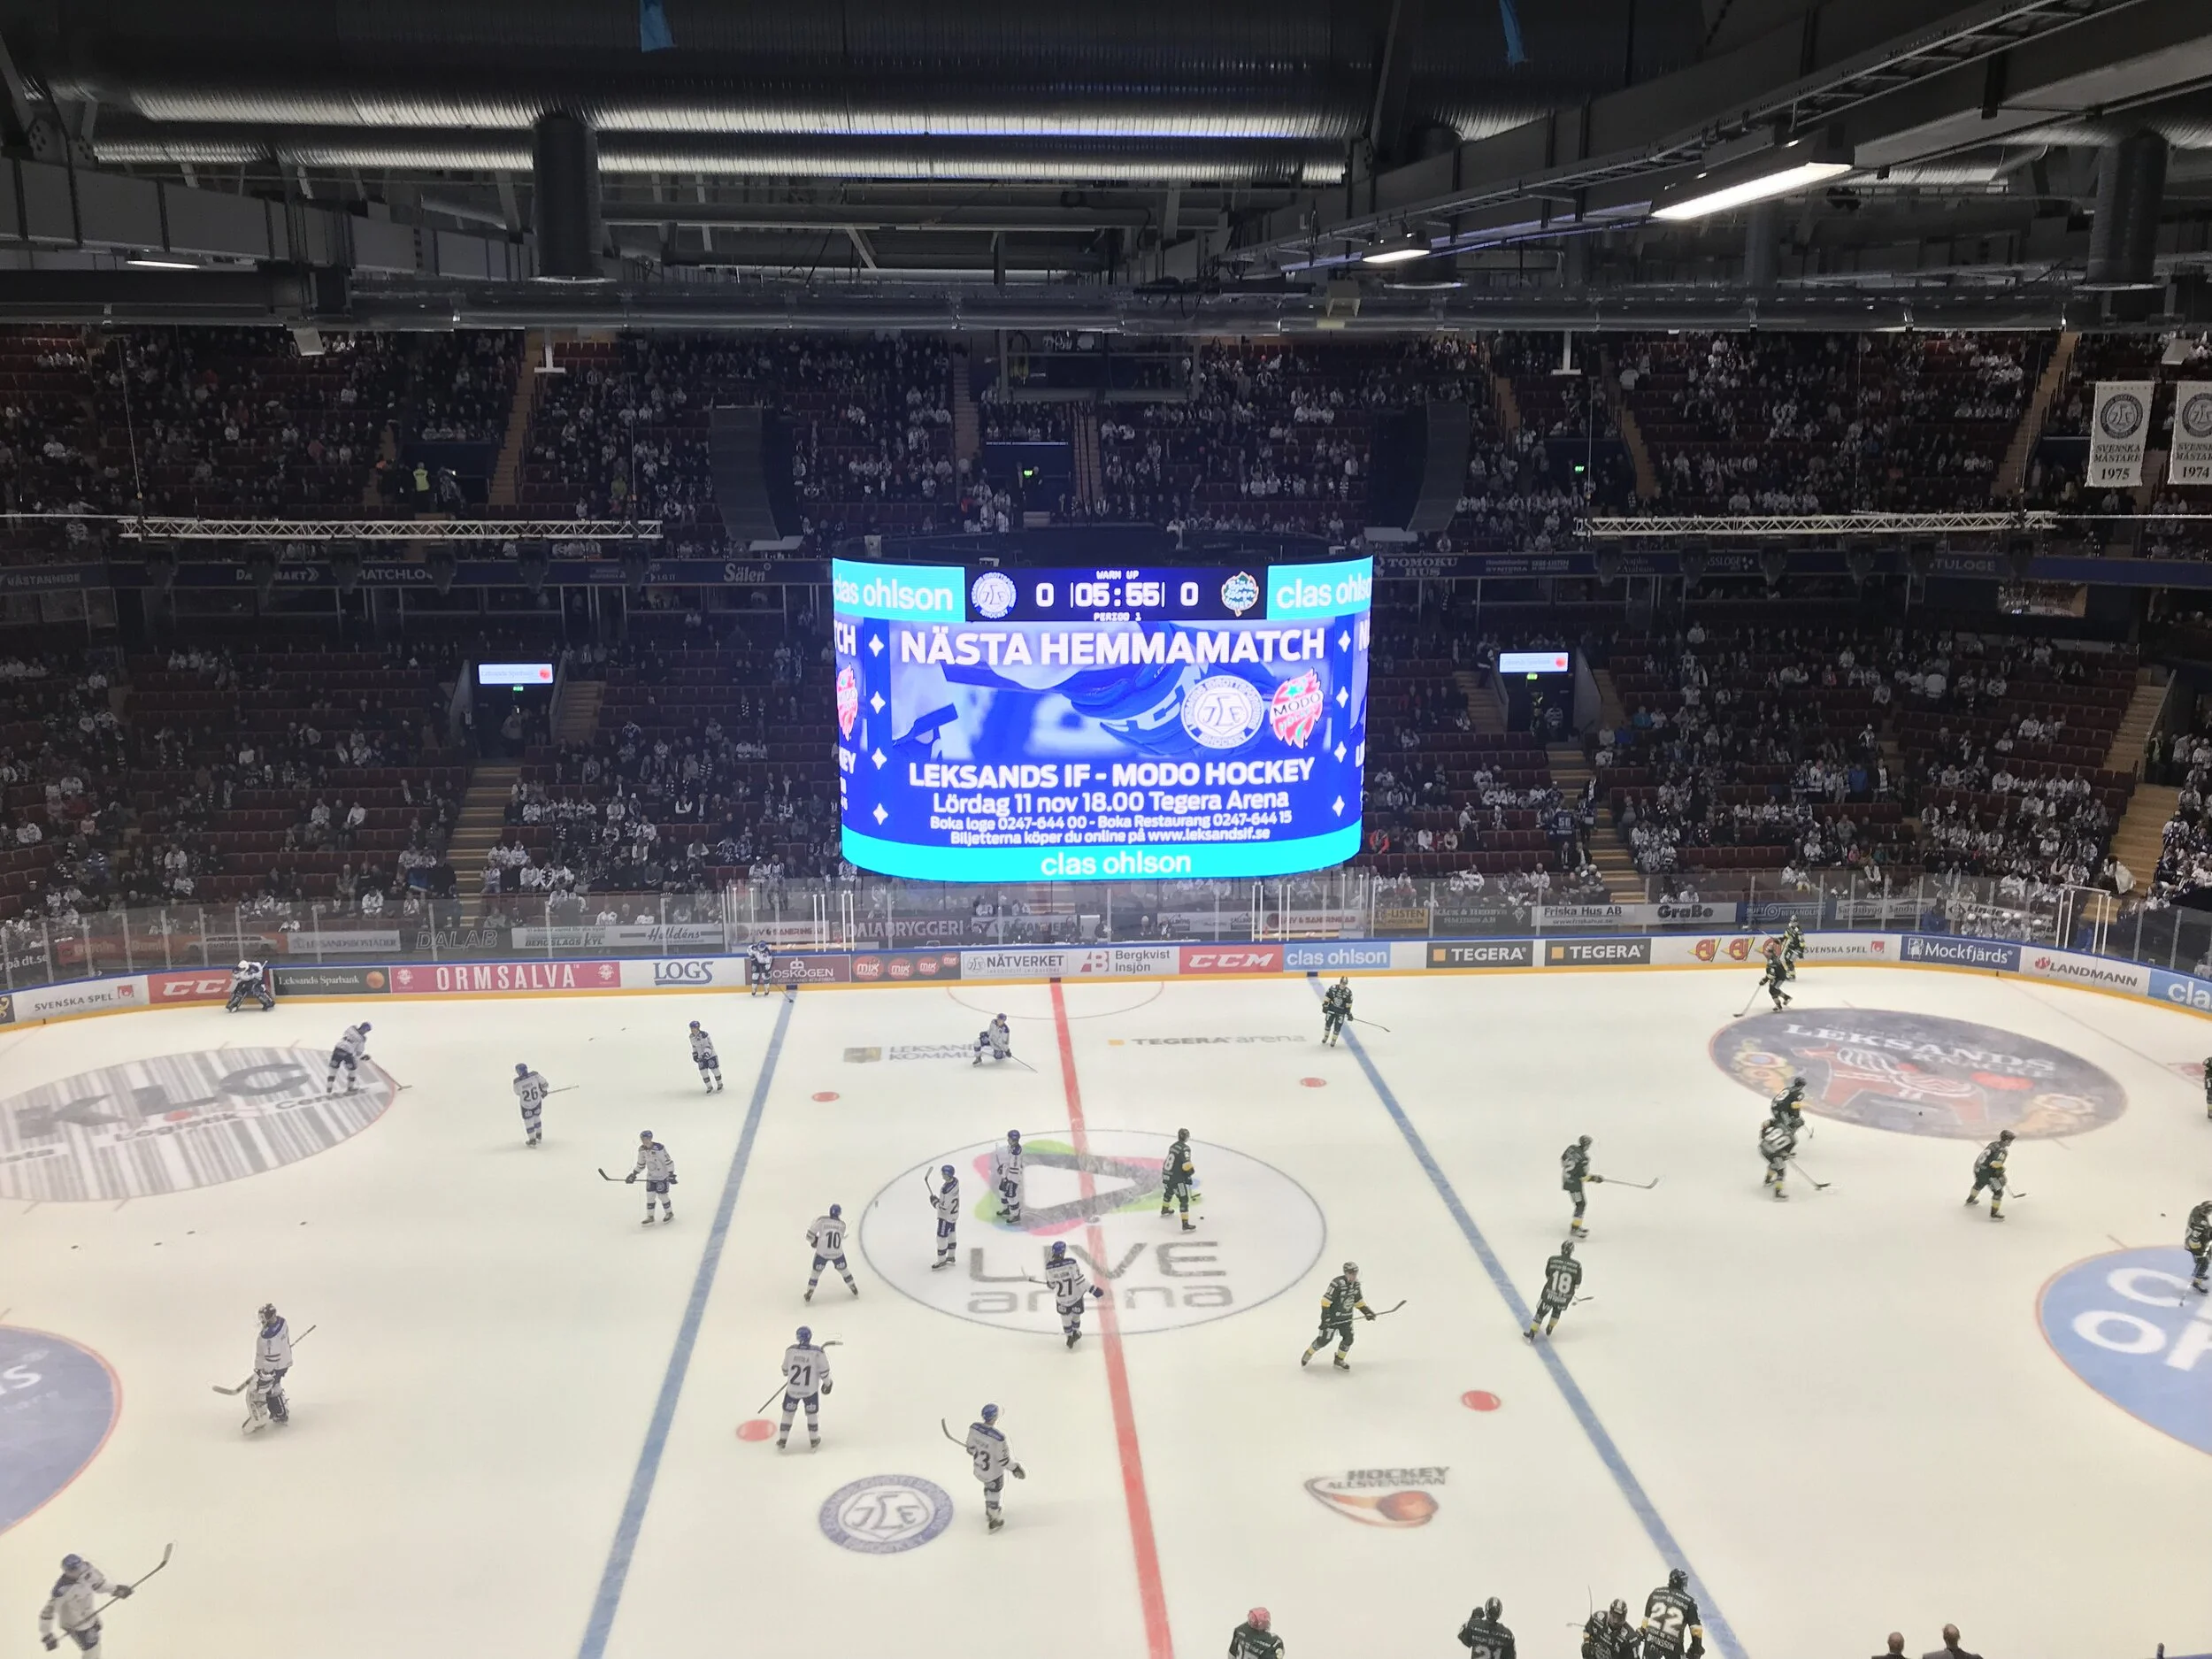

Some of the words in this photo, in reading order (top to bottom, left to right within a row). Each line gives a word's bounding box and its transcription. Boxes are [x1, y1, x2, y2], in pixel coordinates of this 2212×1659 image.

[2101, 468, 2131, 480] 1975
[2183, 466, 2210, 479] 1974
[1096, 571, 1122, 580] WARM
[1125, 571, 1140, 580] UP
[863, 577, 954, 611] ohlson
[1035, 582, 1055, 607] 0
[1179, 581, 1199, 607] 0
[1276, 578, 1332, 609] clas
[901, 626, 1033, 665] NÄSTA
[1040, 627, 1325, 665] HEMMAMATCH
[1273, 692, 1322, 717] MODO
[909, 762, 1058, 789] LEKSANDS
[1064, 764, 1091, 788] IF
[1112, 762, 1200, 787] MODO
[1205, 756, 1316, 786] HOCKEY
[933, 792, 1010, 818] Lördag
[1014, 793, 1032, 813] 11
[1037, 795, 1078, 813] nov
[1082, 792, 1145, 813] 18.00
[1148, 791, 1223, 816] Tegera
[1225, 789, 1289, 811] Arena
[930, 816, 964, 830] Boka
[966, 817, 995, 832] loge
[997, 816, 1064, 830] 0247-644
[1067, 817, 1087, 830] 00
[1098, 814, 1132, 829] Boka
[1134, 812, 1210, 831] Restaurang
[1213, 811, 1277, 827] 0247-644
[1279, 810, 1293, 825] 15
[951, 830, 1022, 847] Biljetterna
[1024, 829, 1062, 846] köper
[1064, 829, 1082, 843] du
[1084, 828, 1125, 844] online
[1128, 827, 1146, 845] på
[1148, 826, 1271, 842] www.leksandsif.se
[1041, 851, 1096, 875] clas
[1102, 850, 1192, 874] ohlson
[1544, 906, 1578, 917] Friska
[1581, 906, 1602, 917] Hus
[1606, 905, 1622, 916] AB
[306, 939, 396, 949] LESANDSBOSTÄDER
[416, 930, 498, 950] DALAB
[1804, 945, 1843, 954] SVENSKA
[1847, 945, 1867, 954] SPEL
[987, 953, 1064, 968] NÄTVERKET
[1115, 950, 1171, 962] Bergkvist
[1189, 953, 1274, 968] CCM
[1286, 949, 1324, 966] clas
[1327, 948, 1387, 964] ohlson
[1924, 941, 2008, 964] Mockfjärds
[436, 964, 576, 991] ORMSALVA
[654, 961, 714, 981] LOGS
[768, 968, 834, 979] OSKOGEN
[1115, 962, 1151, 974] Insjön
[2049, 961, 2138, 987] LANDMANN
[163, 978, 235, 996] CC
[320, 975, 359, 987] Sparbank
[35, 996, 84, 1011] SVENSKA
[88, 994, 113, 1003] SPEL
[2168, 980, 2212, 1010] cla
[890, 1044, 977, 1053] LEKSAN
[1235, 1034, 1307, 1045] arena
[1784, 1023, 2055, 1071] LEKSANDS
[522, 1086, 539, 1102] 26
[826, 1231, 841, 1249] 10
[1056, 1278, 1073, 1298] 27
[1551, 1269, 1573, 1294] 18
[968, 1284, 1233, 1315] arna
[790, 1363, 812, 1386] 21
[1347, 1466, 1450, 1481] HOCKEY
[1649, 1601, 1685, 1638] 22
